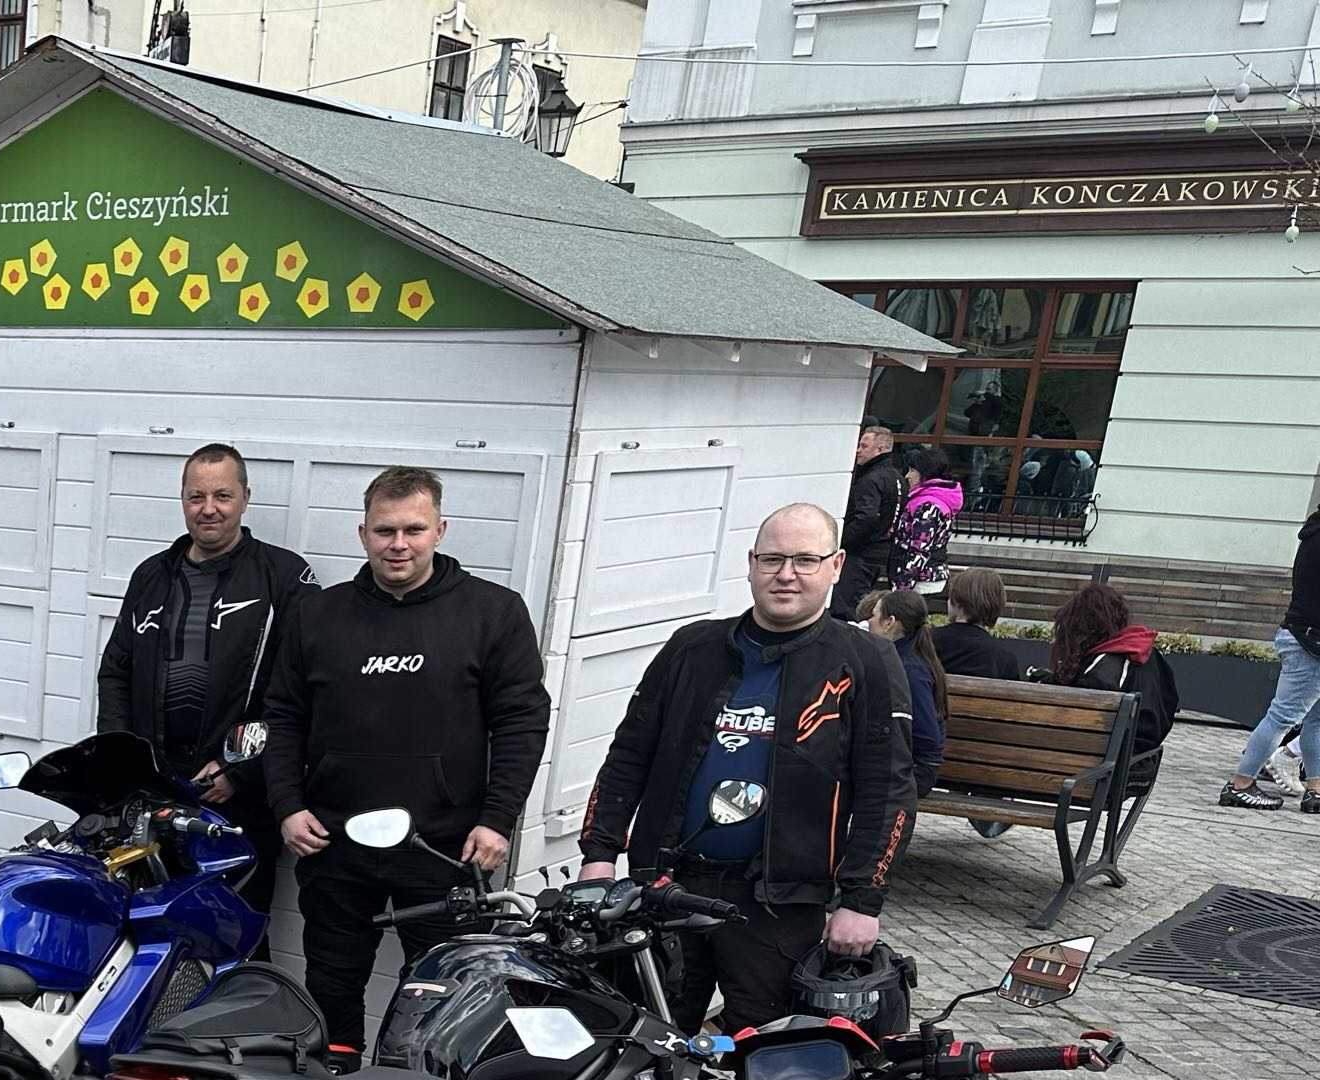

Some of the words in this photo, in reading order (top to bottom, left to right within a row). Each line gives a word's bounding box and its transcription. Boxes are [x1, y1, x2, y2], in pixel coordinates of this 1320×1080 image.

[86, 186, 230, 226] Cieszyński
[832, 186, 1009, 211] KAMIENICA
[1031, 177, 1320, 206] KONCZAKOWSKI
[361, 654, 425, 675] JARKO
